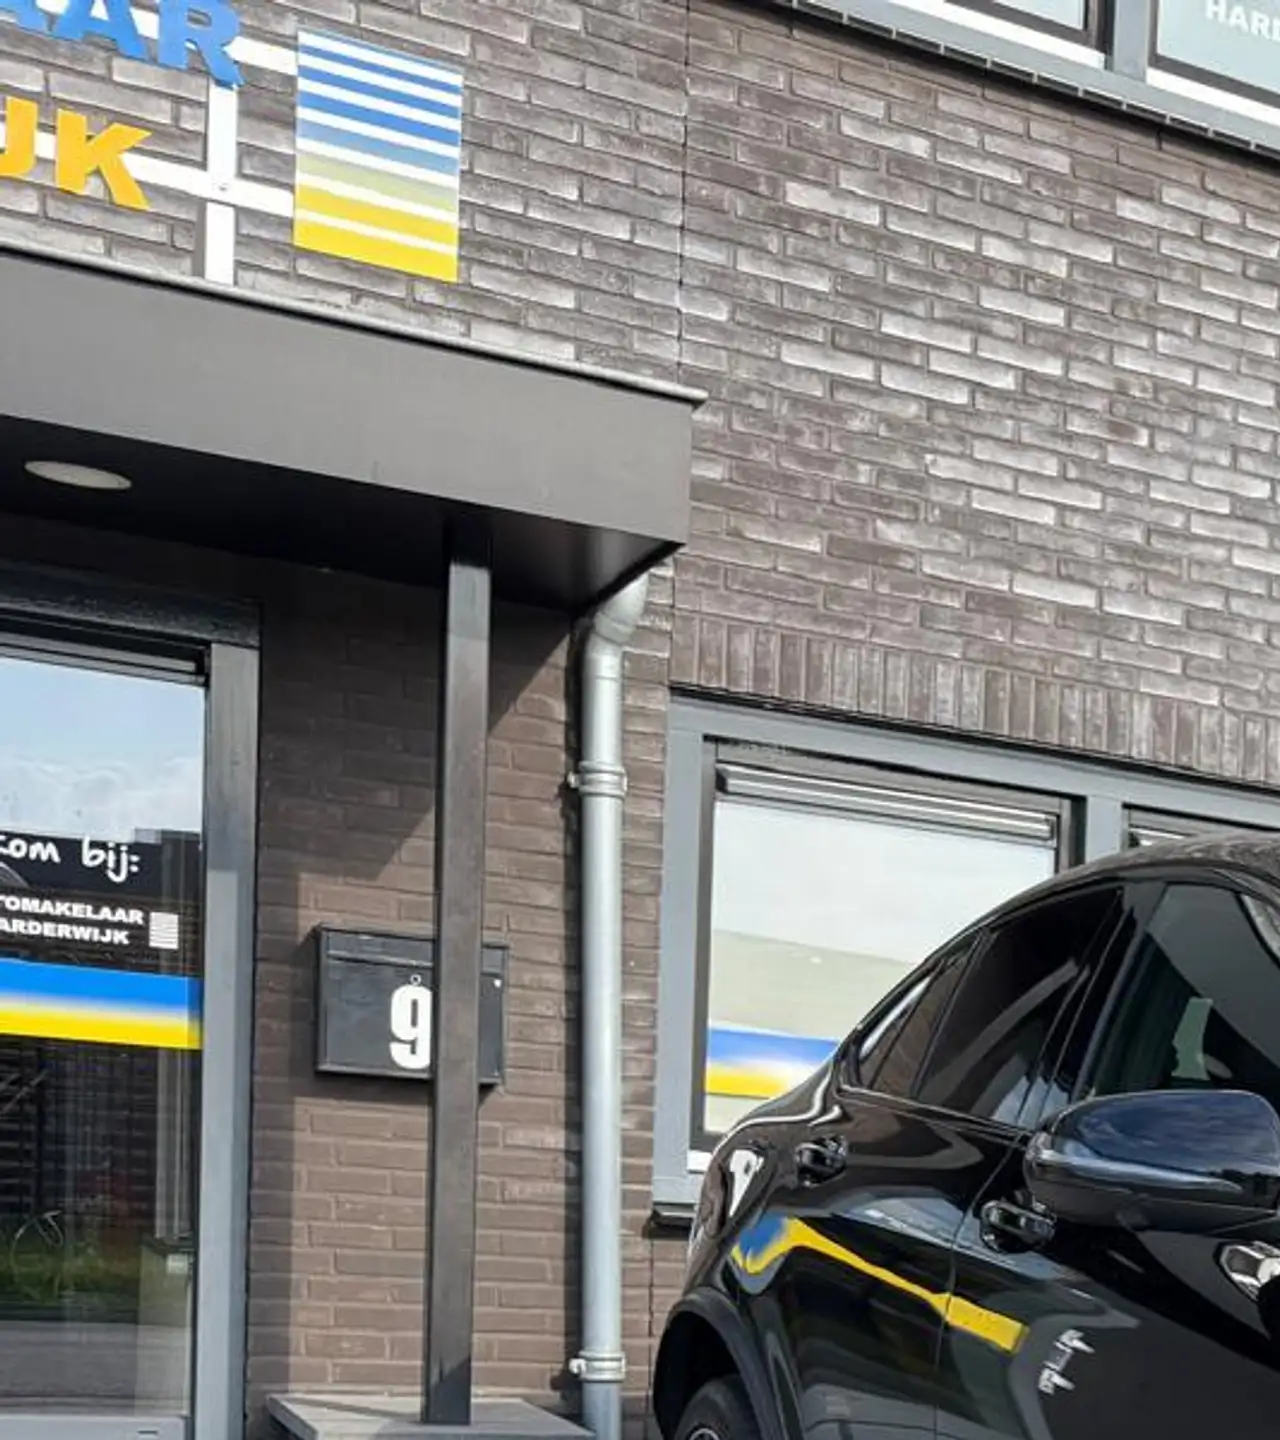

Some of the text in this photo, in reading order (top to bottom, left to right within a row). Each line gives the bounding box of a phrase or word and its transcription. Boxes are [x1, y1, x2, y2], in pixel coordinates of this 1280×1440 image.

[0, 0, 244, 90] AR
[82, 836, 141, 883] bij:
[390, 984, 432, 1069] 9
